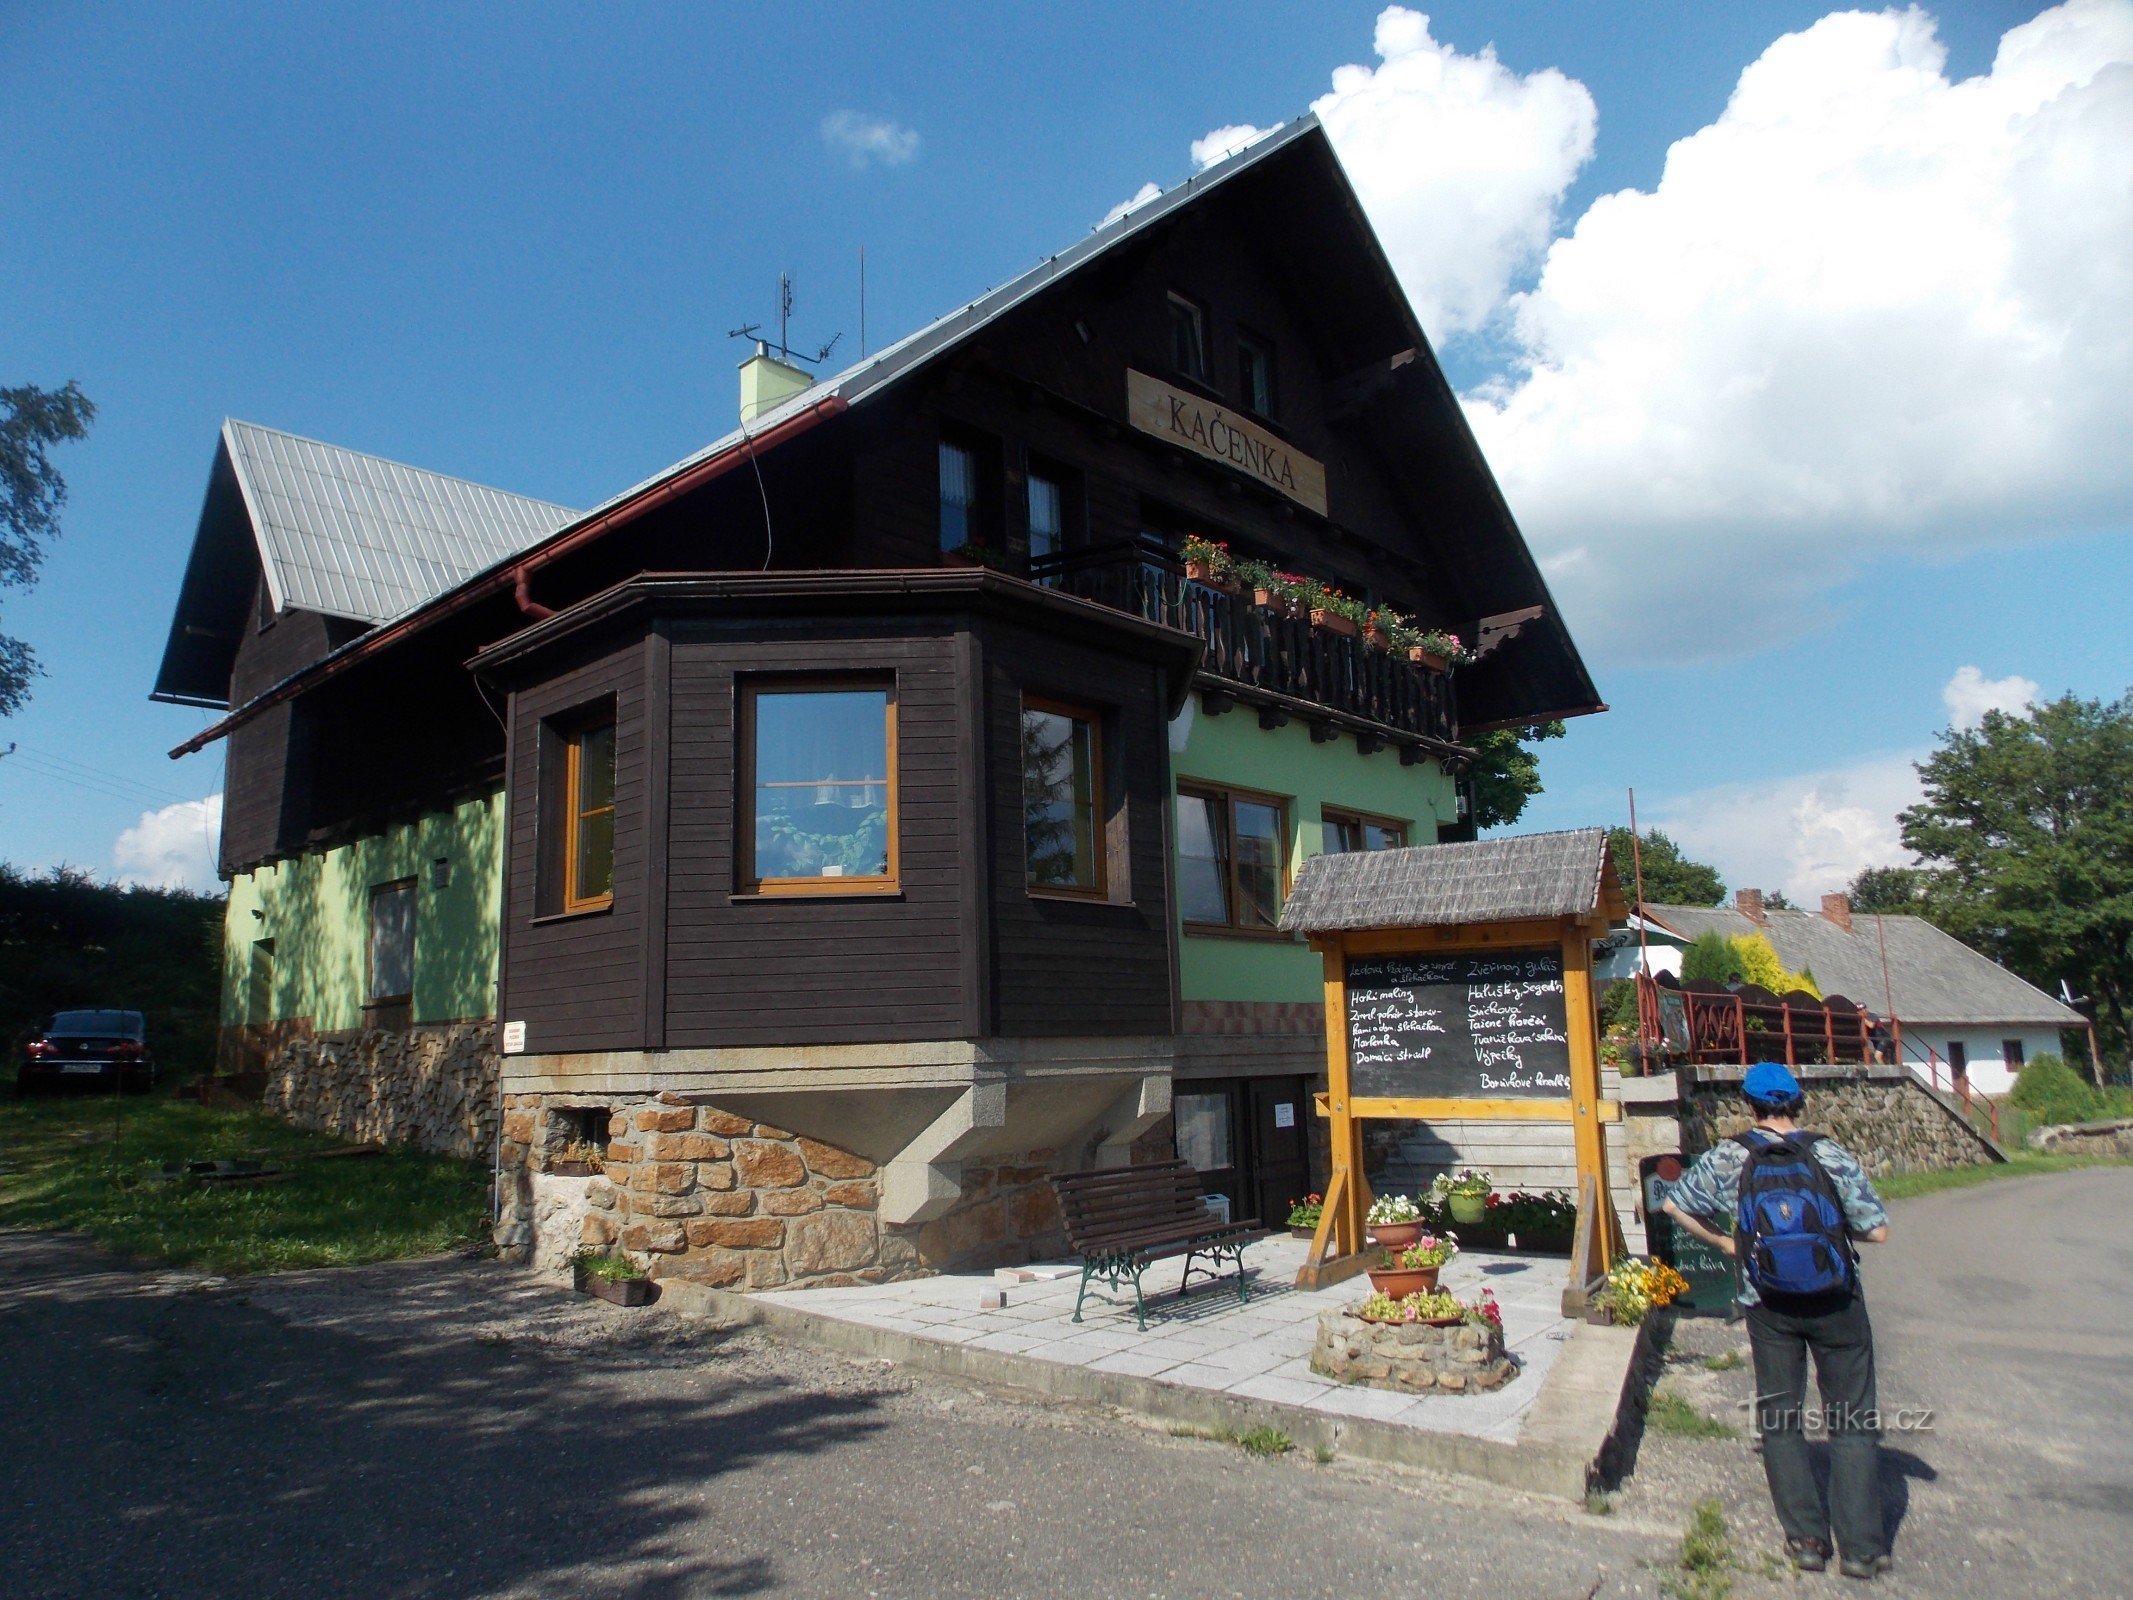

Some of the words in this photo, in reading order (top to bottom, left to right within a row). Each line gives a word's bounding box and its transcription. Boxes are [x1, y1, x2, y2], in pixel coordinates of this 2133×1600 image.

[1168, 395, 1297, 491] KAČENKA
[1379, 987, 1414, 1004] maliny
[1352, 1034, 1400, 1050] Marlenka
